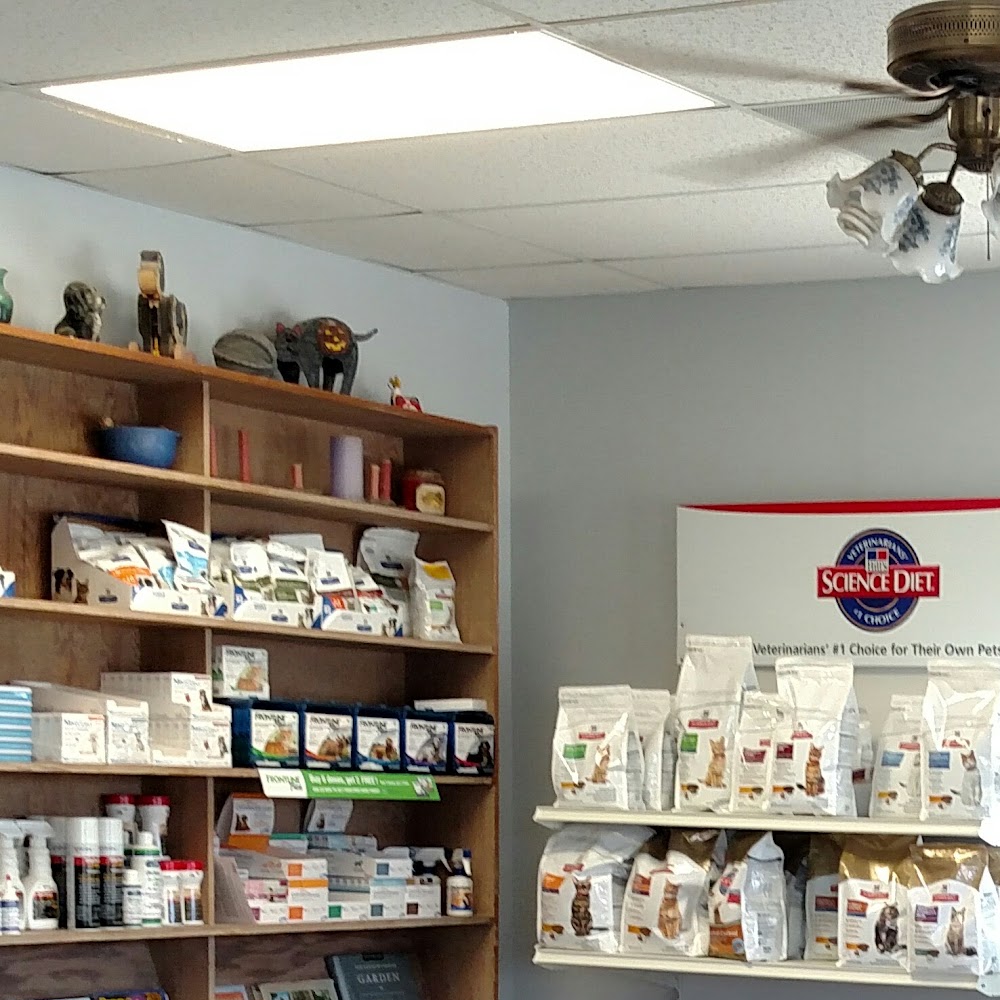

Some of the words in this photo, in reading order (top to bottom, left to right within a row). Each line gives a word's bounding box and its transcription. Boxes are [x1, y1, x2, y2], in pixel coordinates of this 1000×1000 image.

[821, 569, 891, 594] SCIENCE
[893, 569, 935, 594] DIET
[863, 607, 902, 626] CHOICE
[832, 643, 846, 656] #1
[849, 643, 887, 656] Choice
[891, 643, 909, 656] for
[911, 643, 941, 656] Their
[944, 643, 974, 656] Own
